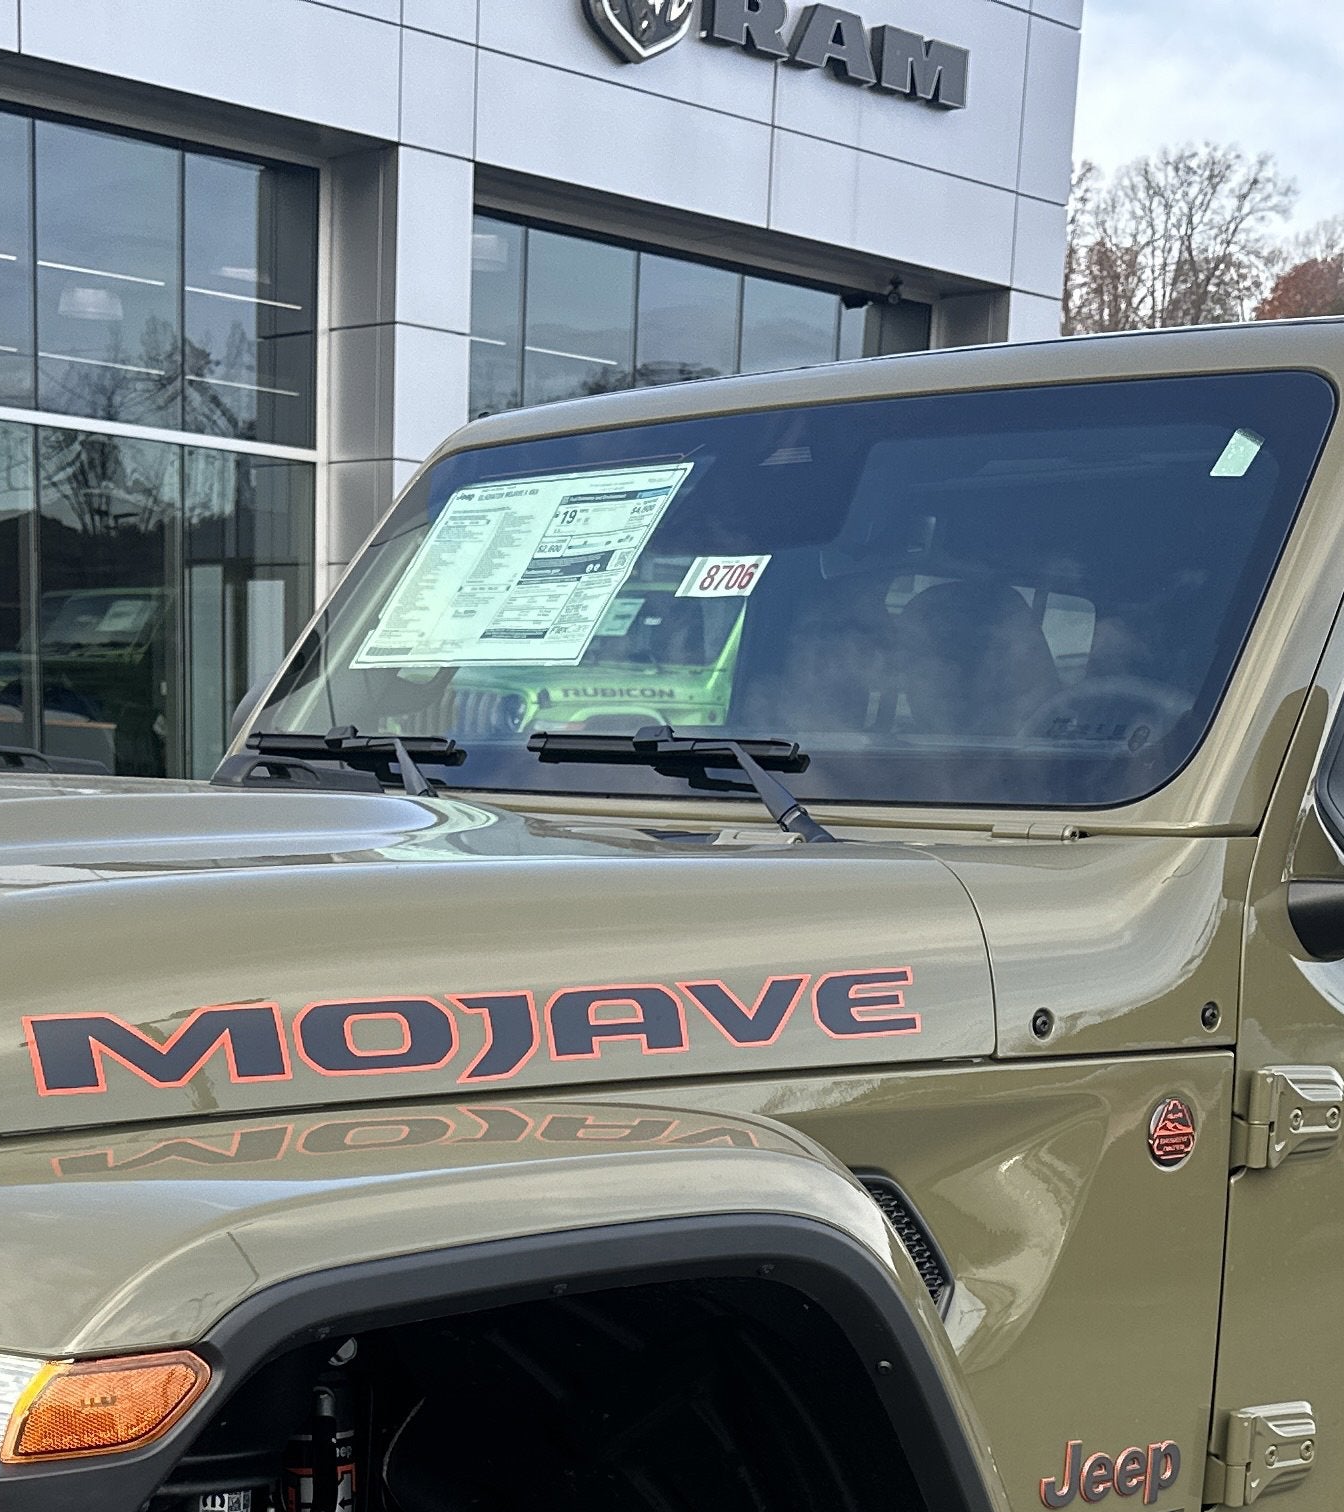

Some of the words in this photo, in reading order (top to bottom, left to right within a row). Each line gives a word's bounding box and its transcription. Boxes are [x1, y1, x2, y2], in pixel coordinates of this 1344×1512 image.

[702, 0, 970, 109] RAM
[560, 509, 578, 525] 19
[699, 563, 759, 591] 8706
[561, 687, 675, 699] RUBICON
[22, 966, 923, 1097] MOJAVE
[1040, 1440, 1181, 1510] Jeep
